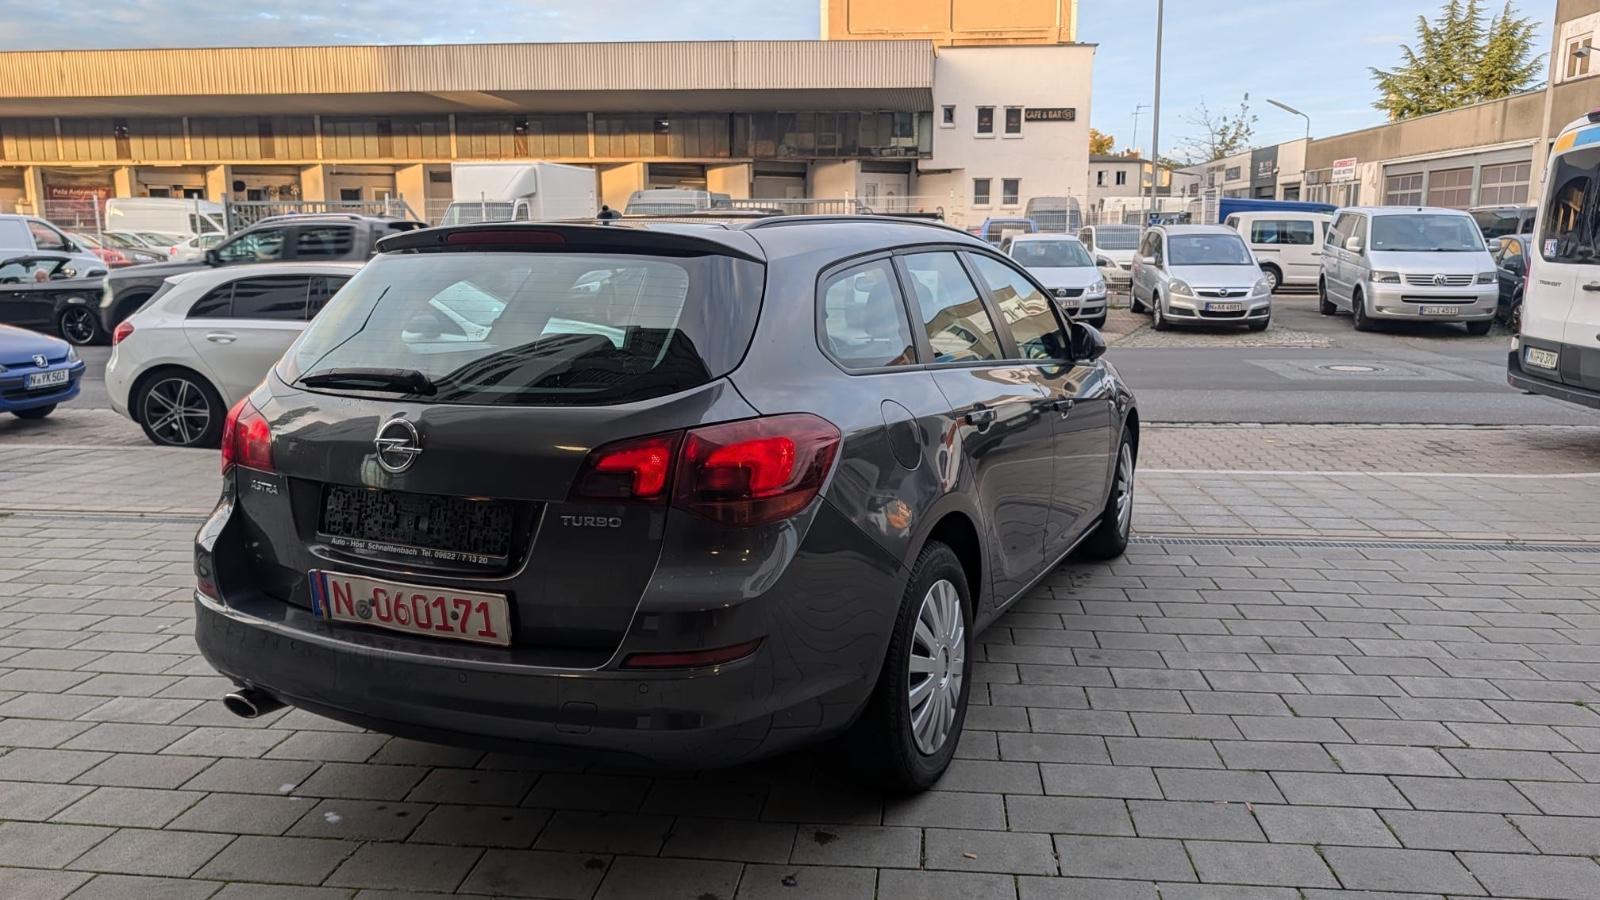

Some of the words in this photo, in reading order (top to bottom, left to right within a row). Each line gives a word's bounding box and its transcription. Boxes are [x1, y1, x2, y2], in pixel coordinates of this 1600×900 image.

[1048, 110, 1062, 119] BAR
[31, 375, 37, 385] N
[42, 373, 51, 384] YK
[250, 479, 279, 495] ASTRA
[560, 515, 622, 528] TURBO
[331, 538, 346, 547] Auto
[422, 549, 433, 558] Tel.
[478, 556, 488, 565] 20
[331, 580, 354, 617] N
[373, 587, 497, 638] 060171
